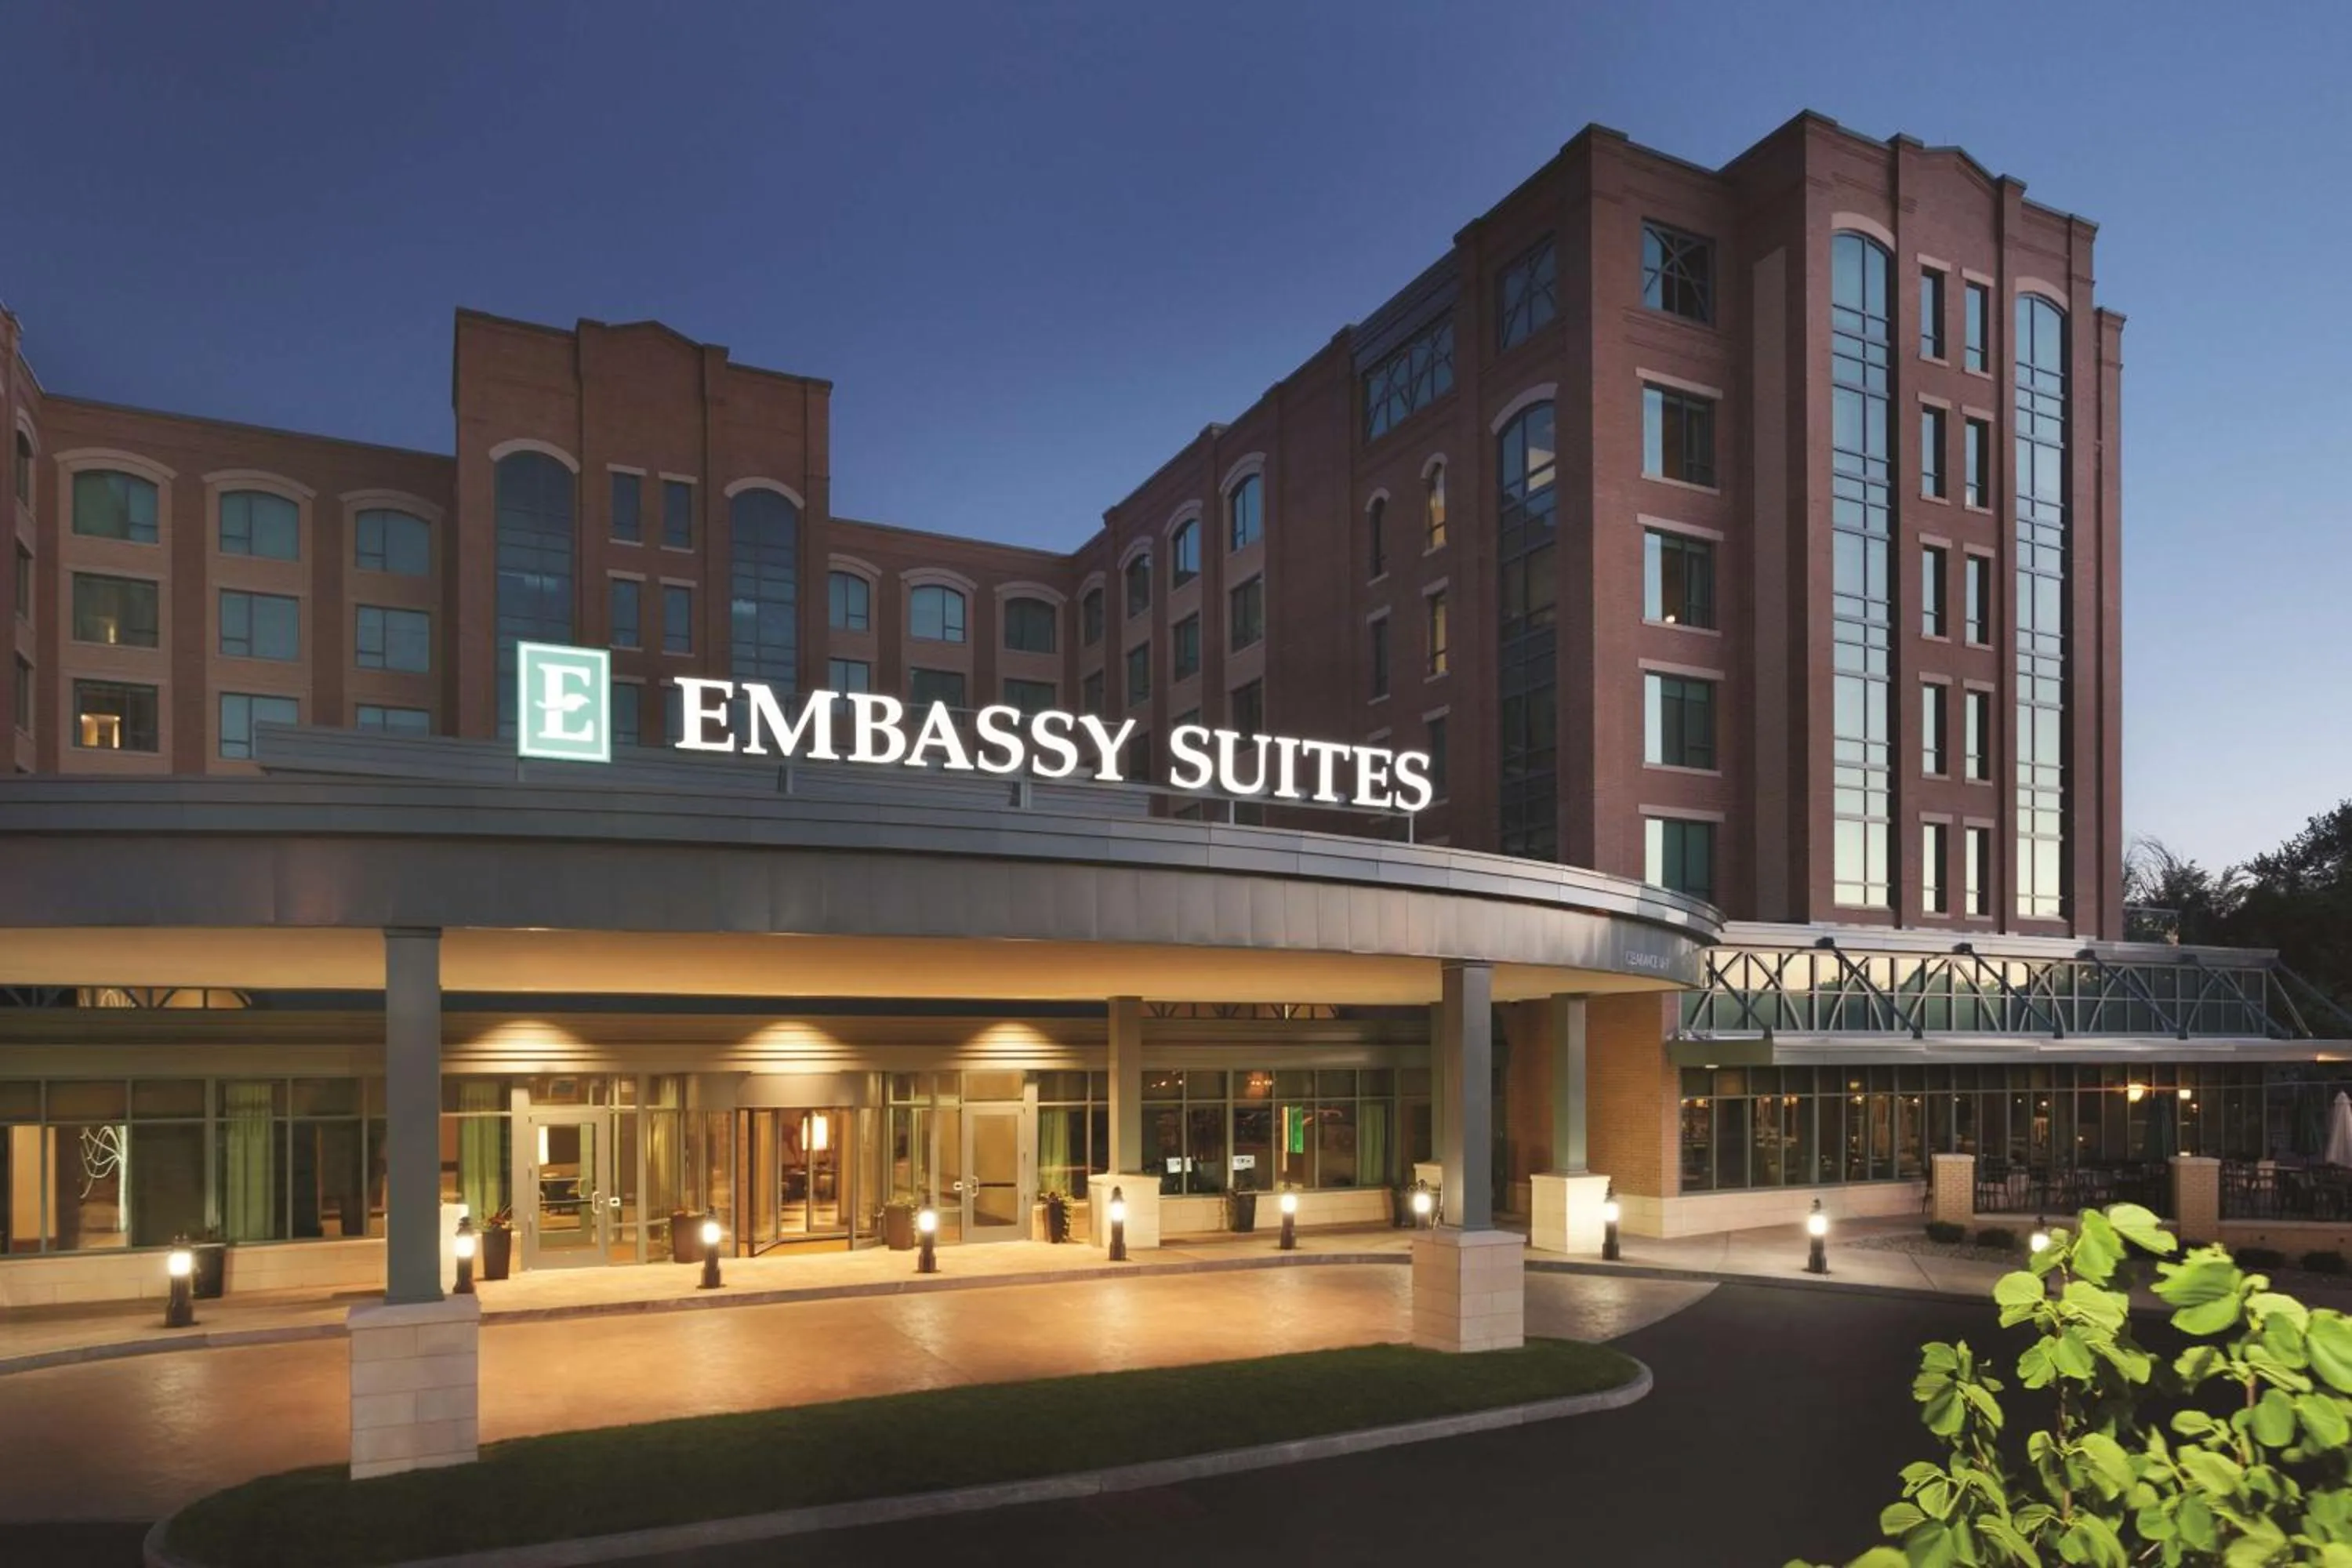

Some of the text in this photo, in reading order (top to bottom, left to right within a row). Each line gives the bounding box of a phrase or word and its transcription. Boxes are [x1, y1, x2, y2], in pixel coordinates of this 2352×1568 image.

[534, 662, 595, 743] E
[673, 676, 1433, 812] EMBASSY SUITES
